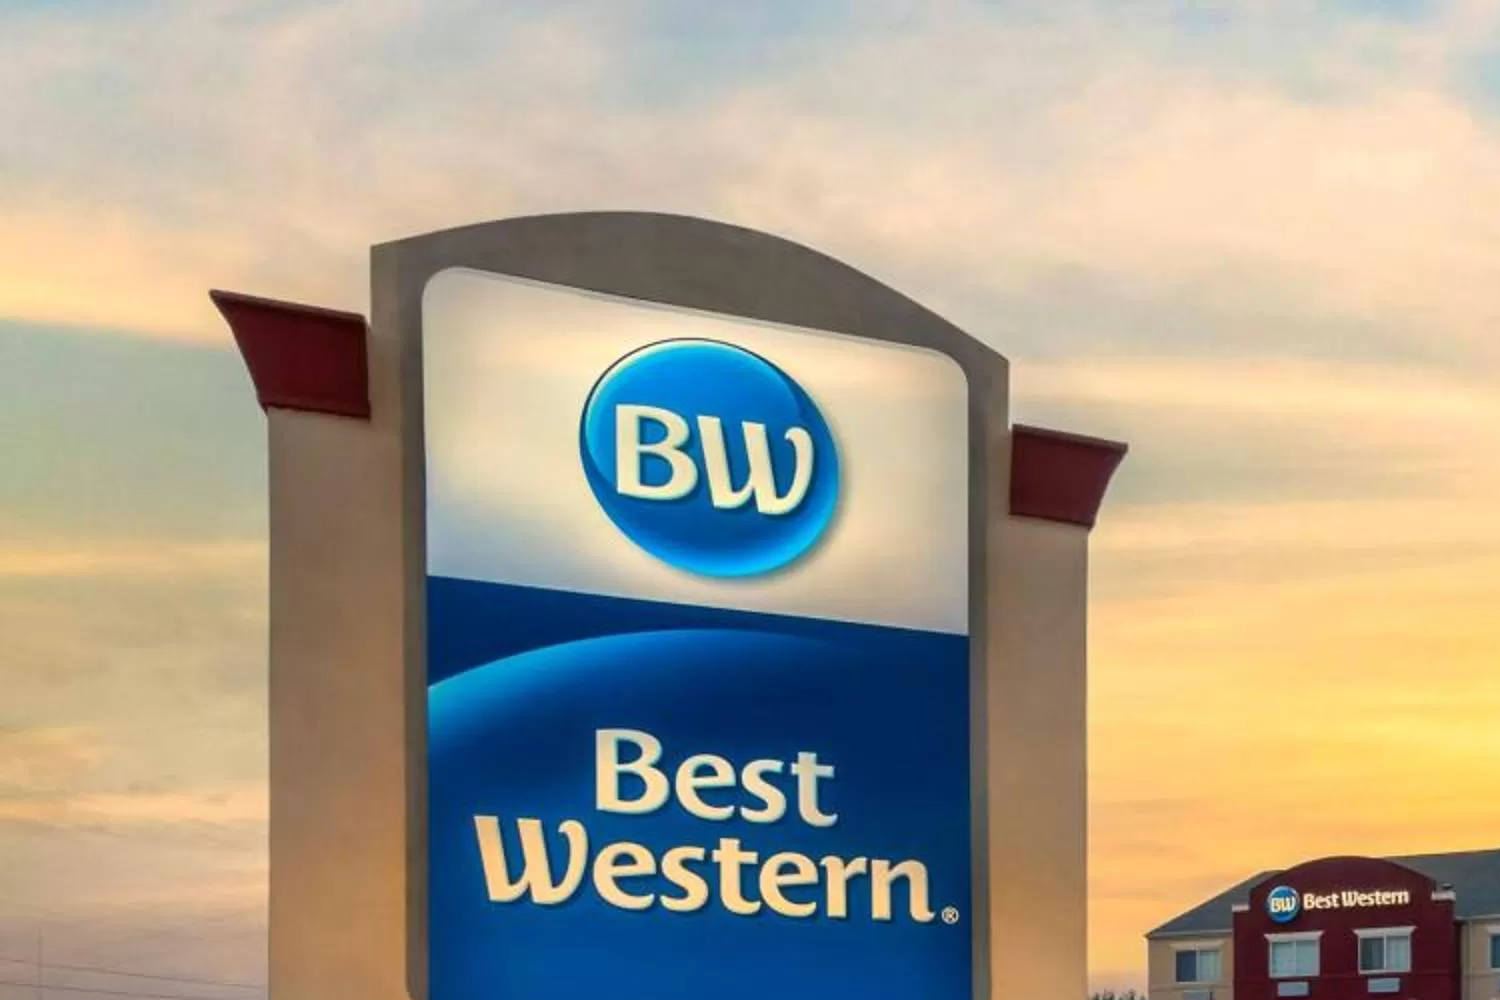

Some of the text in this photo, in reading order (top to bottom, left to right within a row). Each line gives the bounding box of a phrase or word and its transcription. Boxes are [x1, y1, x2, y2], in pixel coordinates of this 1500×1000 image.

[614, 403, 814, 516] BW
[594, 728, 839, 828] Best
[1270, 890, 1409, 912] BW Best Western
